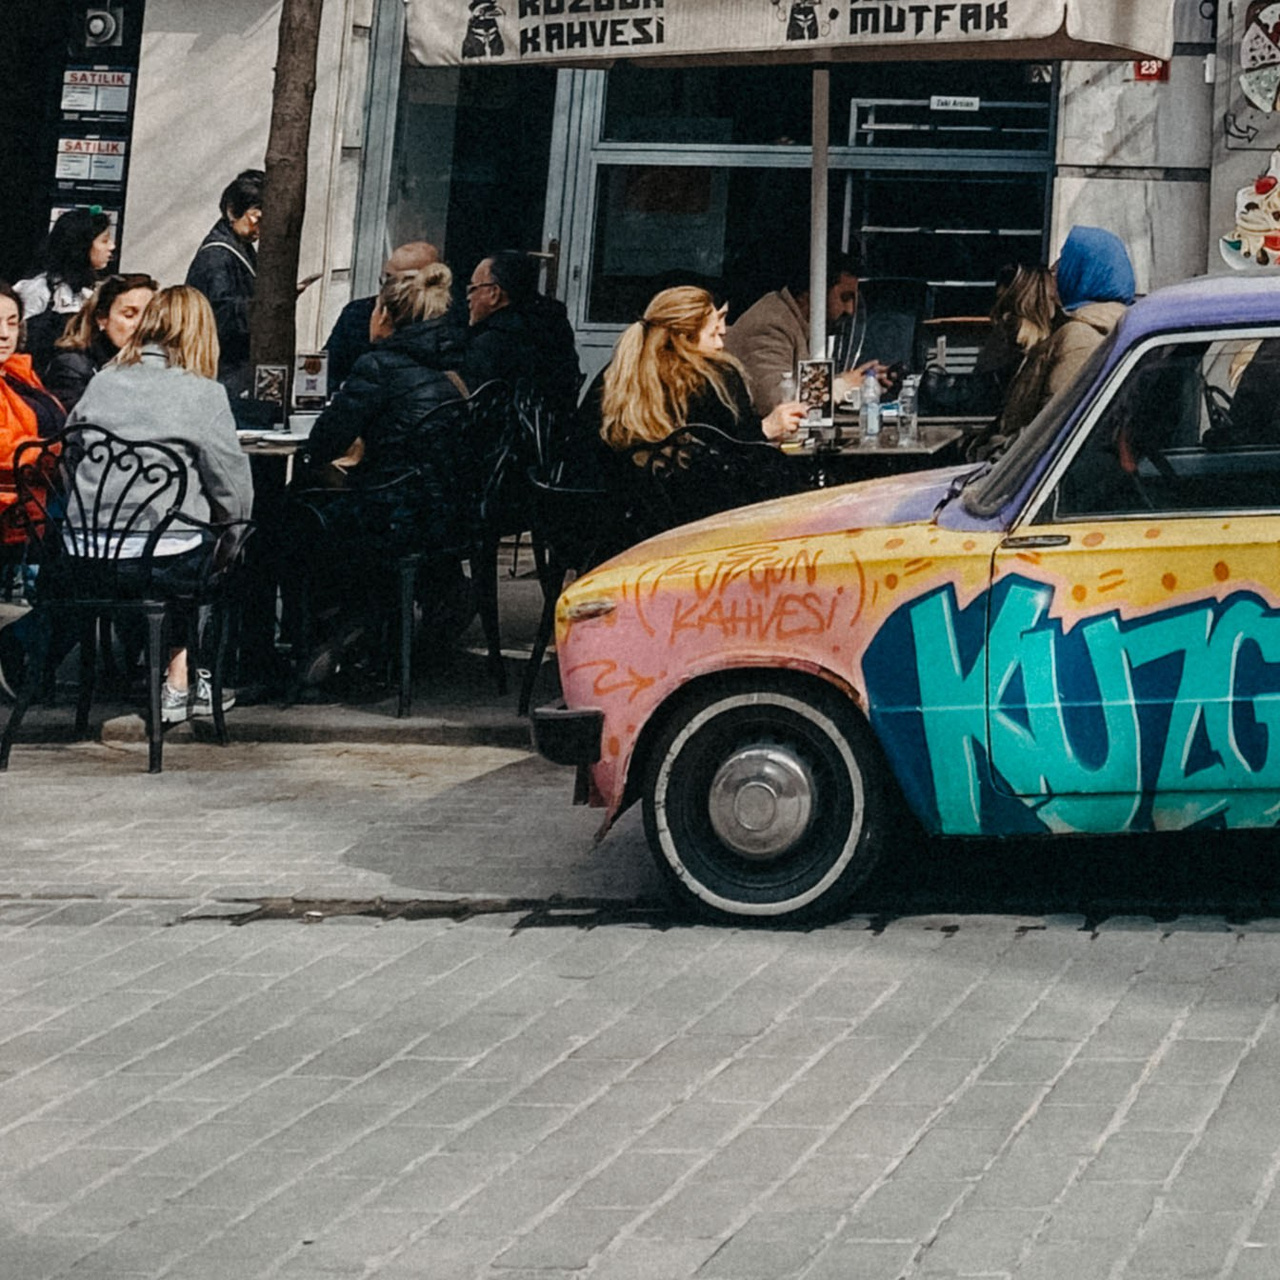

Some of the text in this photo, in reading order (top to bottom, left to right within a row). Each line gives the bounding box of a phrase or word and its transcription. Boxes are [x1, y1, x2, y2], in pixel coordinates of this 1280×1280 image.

[850, 0, 1008, 36] MUTFAK
[69, 72, 126, 85] SATILIK
[64, 140, 120, 153] SATILIK
